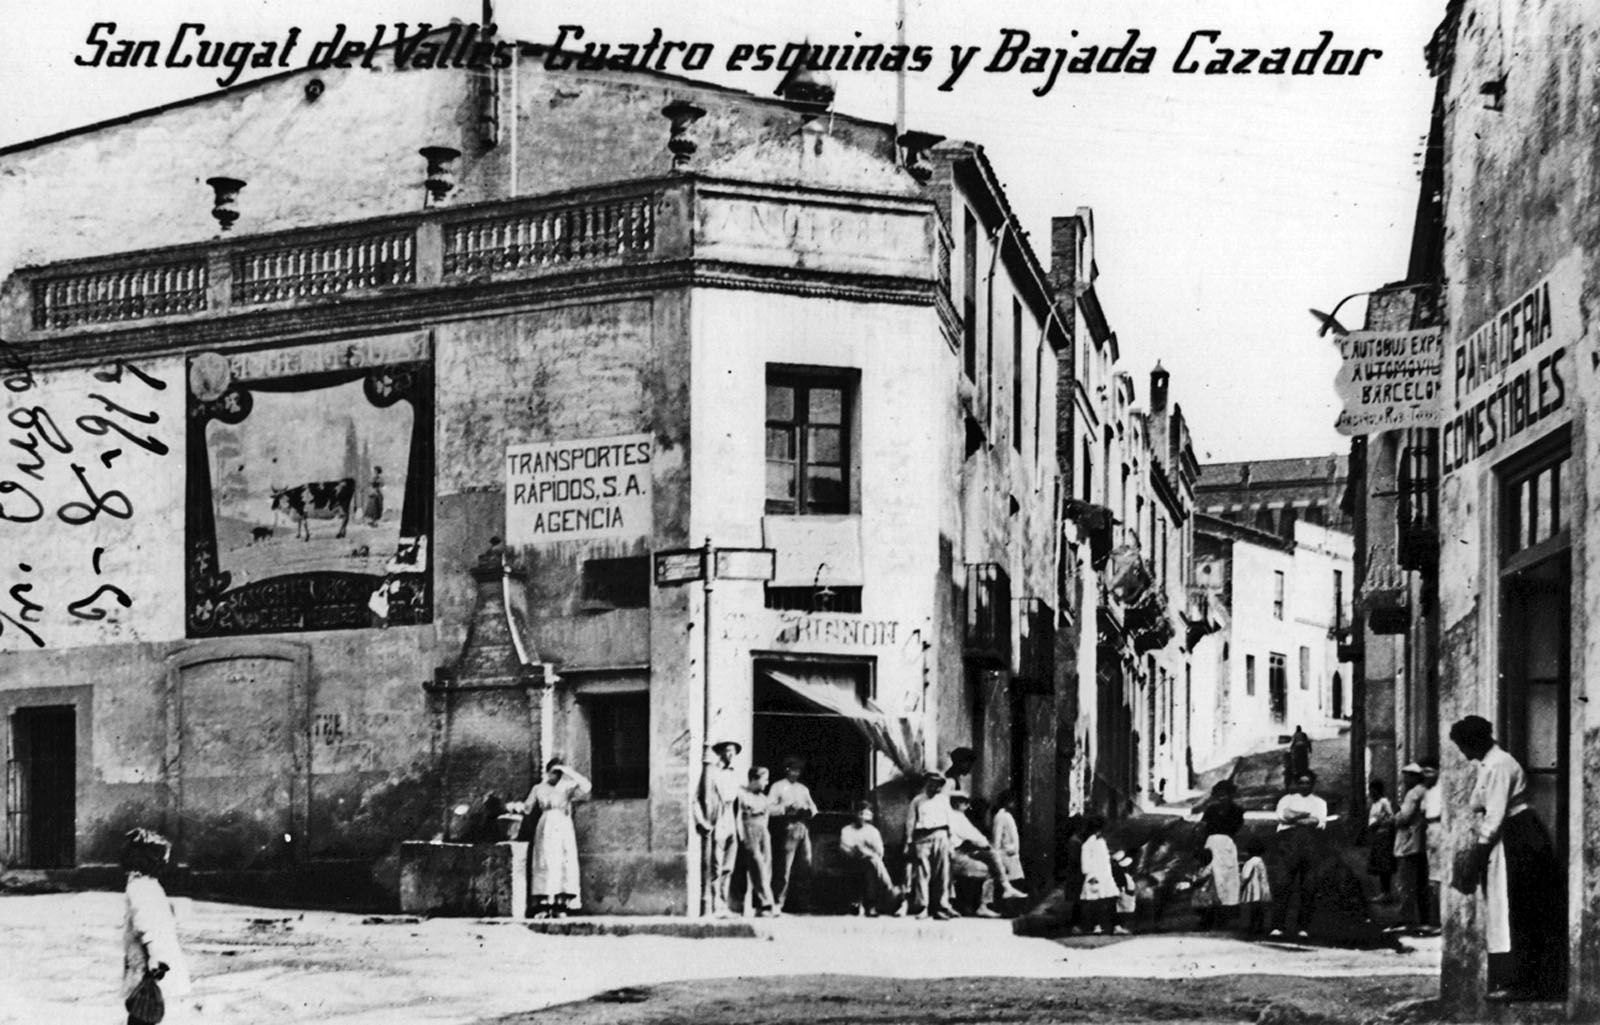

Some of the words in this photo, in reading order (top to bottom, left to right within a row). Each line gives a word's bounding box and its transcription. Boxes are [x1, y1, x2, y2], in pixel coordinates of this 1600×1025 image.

[1351, 338, 1406, 360] AUTOBUS
[1443, 346, 1566, 477] COMESTIBLES
[507, 442, 650, 476] TRANSPORTES
